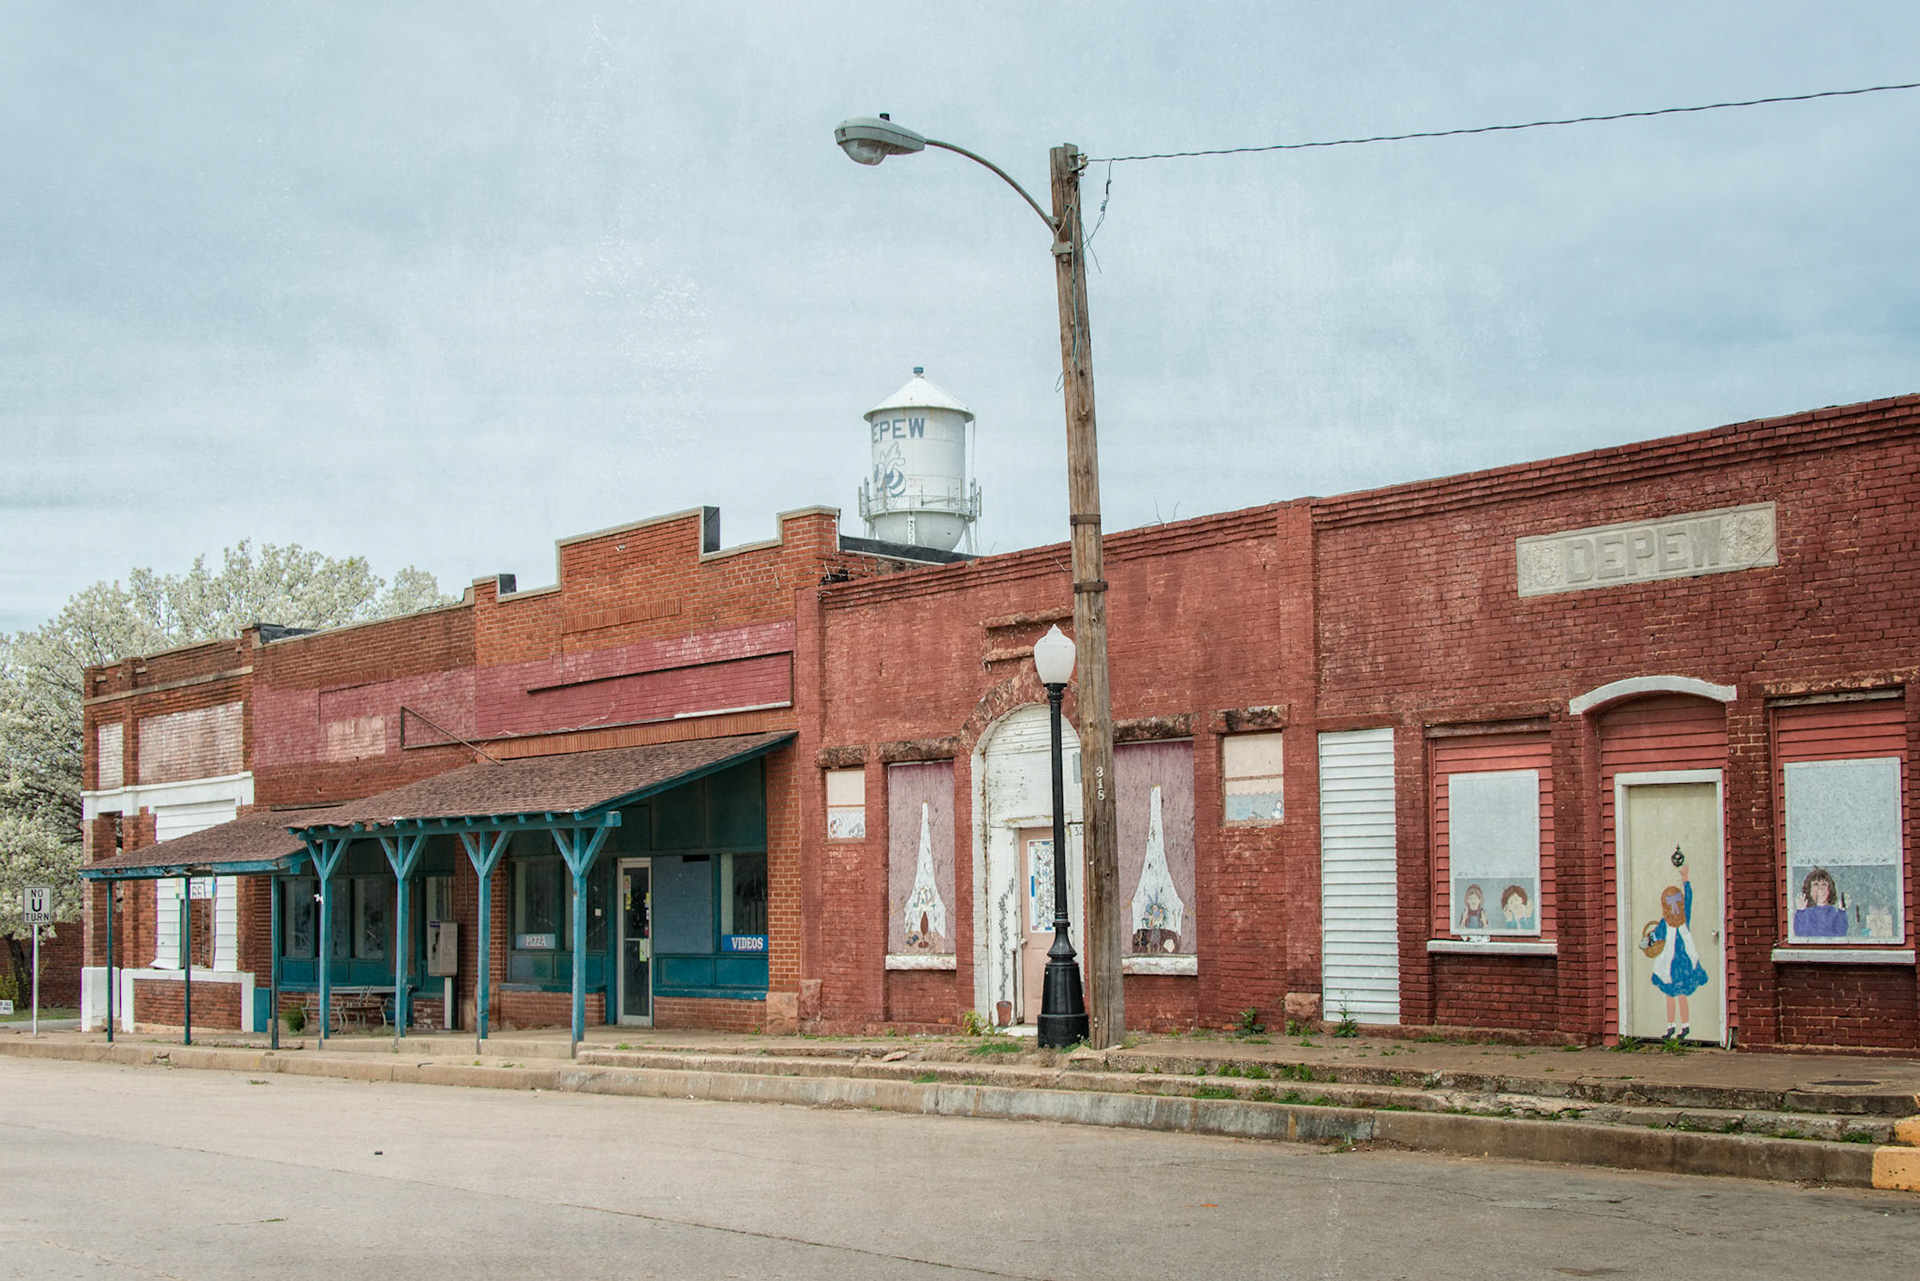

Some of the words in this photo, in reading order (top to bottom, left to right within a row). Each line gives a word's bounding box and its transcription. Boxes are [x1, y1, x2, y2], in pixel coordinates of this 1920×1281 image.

[1567, 518, 1721, 583] DEPEW
[1096, 766, 1105, 800] 318
[31, 889, 43, 898] NO
[32, 899, 42, 912] U
[25, 912, 49, 921] TURN
[525, 936, 547, 947] PIZZA
[731, 936, 764, 950] VIDEOS
